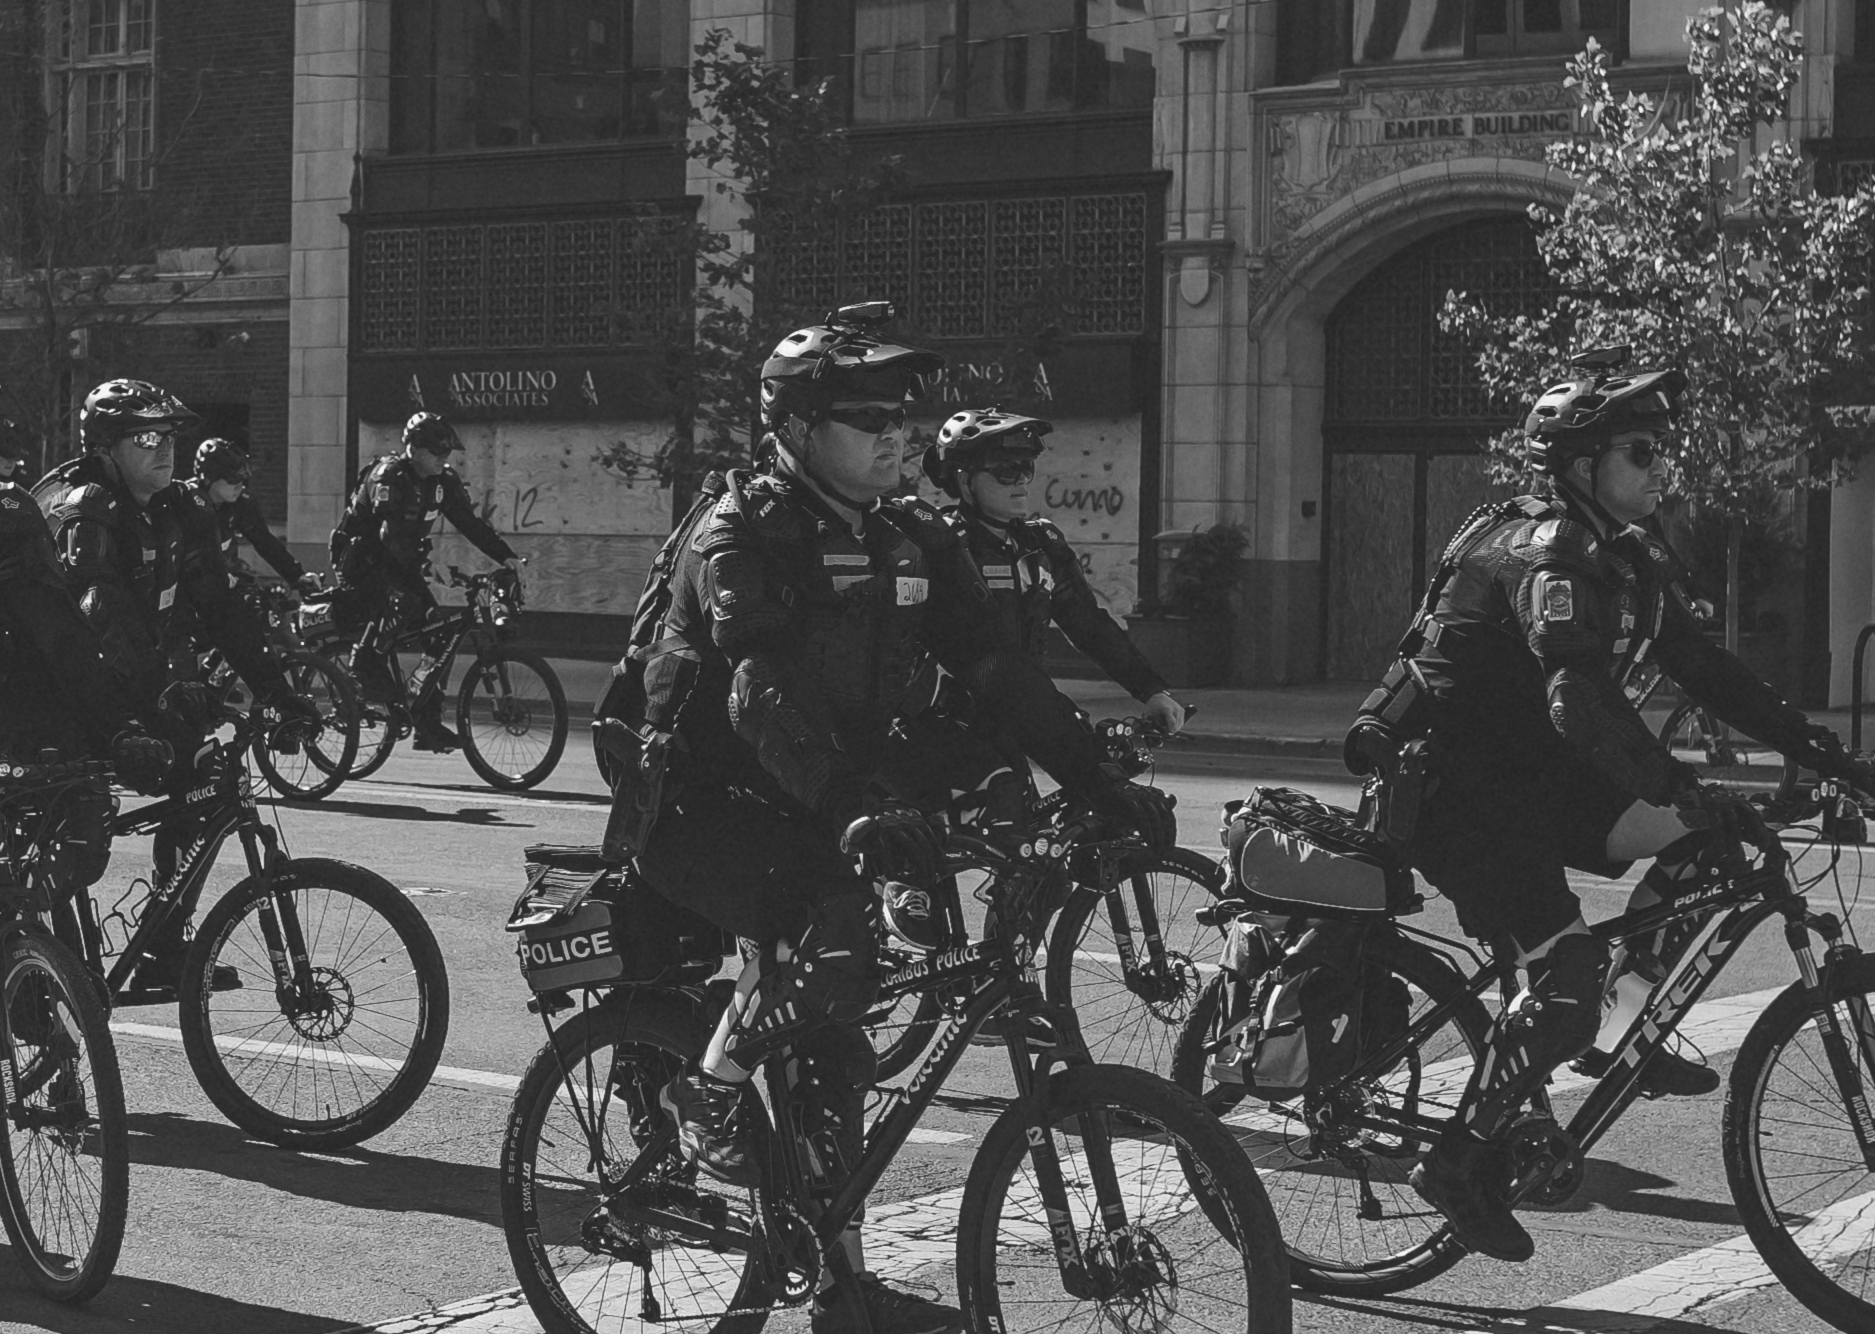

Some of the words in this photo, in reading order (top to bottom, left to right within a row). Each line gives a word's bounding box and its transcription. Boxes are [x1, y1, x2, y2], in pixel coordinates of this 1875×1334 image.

[1384, 118, 1465, 140] EMPIRE
[1473, 113, 1570, 136] BUILDING
[448, 370, 557, 392] ANTOLINO
[451, 391, 549, 408] ASSOCIATES
[512, 487, 544, 532] 12
[759, 498, 776, 518] FOX
[186, 784, 218, 804] POLICE
[1031, 792, 1061, 813] POLICE
[520, 930, 613, 965] POLICE
[1121, 944, 1139, 973] FOX
[880, 961, 929, 988] LUMBUS
[936, 947, 981, 971] POLICE
[1624, 925, 1733, 1069] TREK
[0, 1058, 18, 1105] ROCKSHOX
[522, 1162, 532, 1181] DT
[522, 1181, 533, 1213] SWISS
[1055, 1223, 1080, 1268] FOX
[987, 1315, 999, 1334] DT
